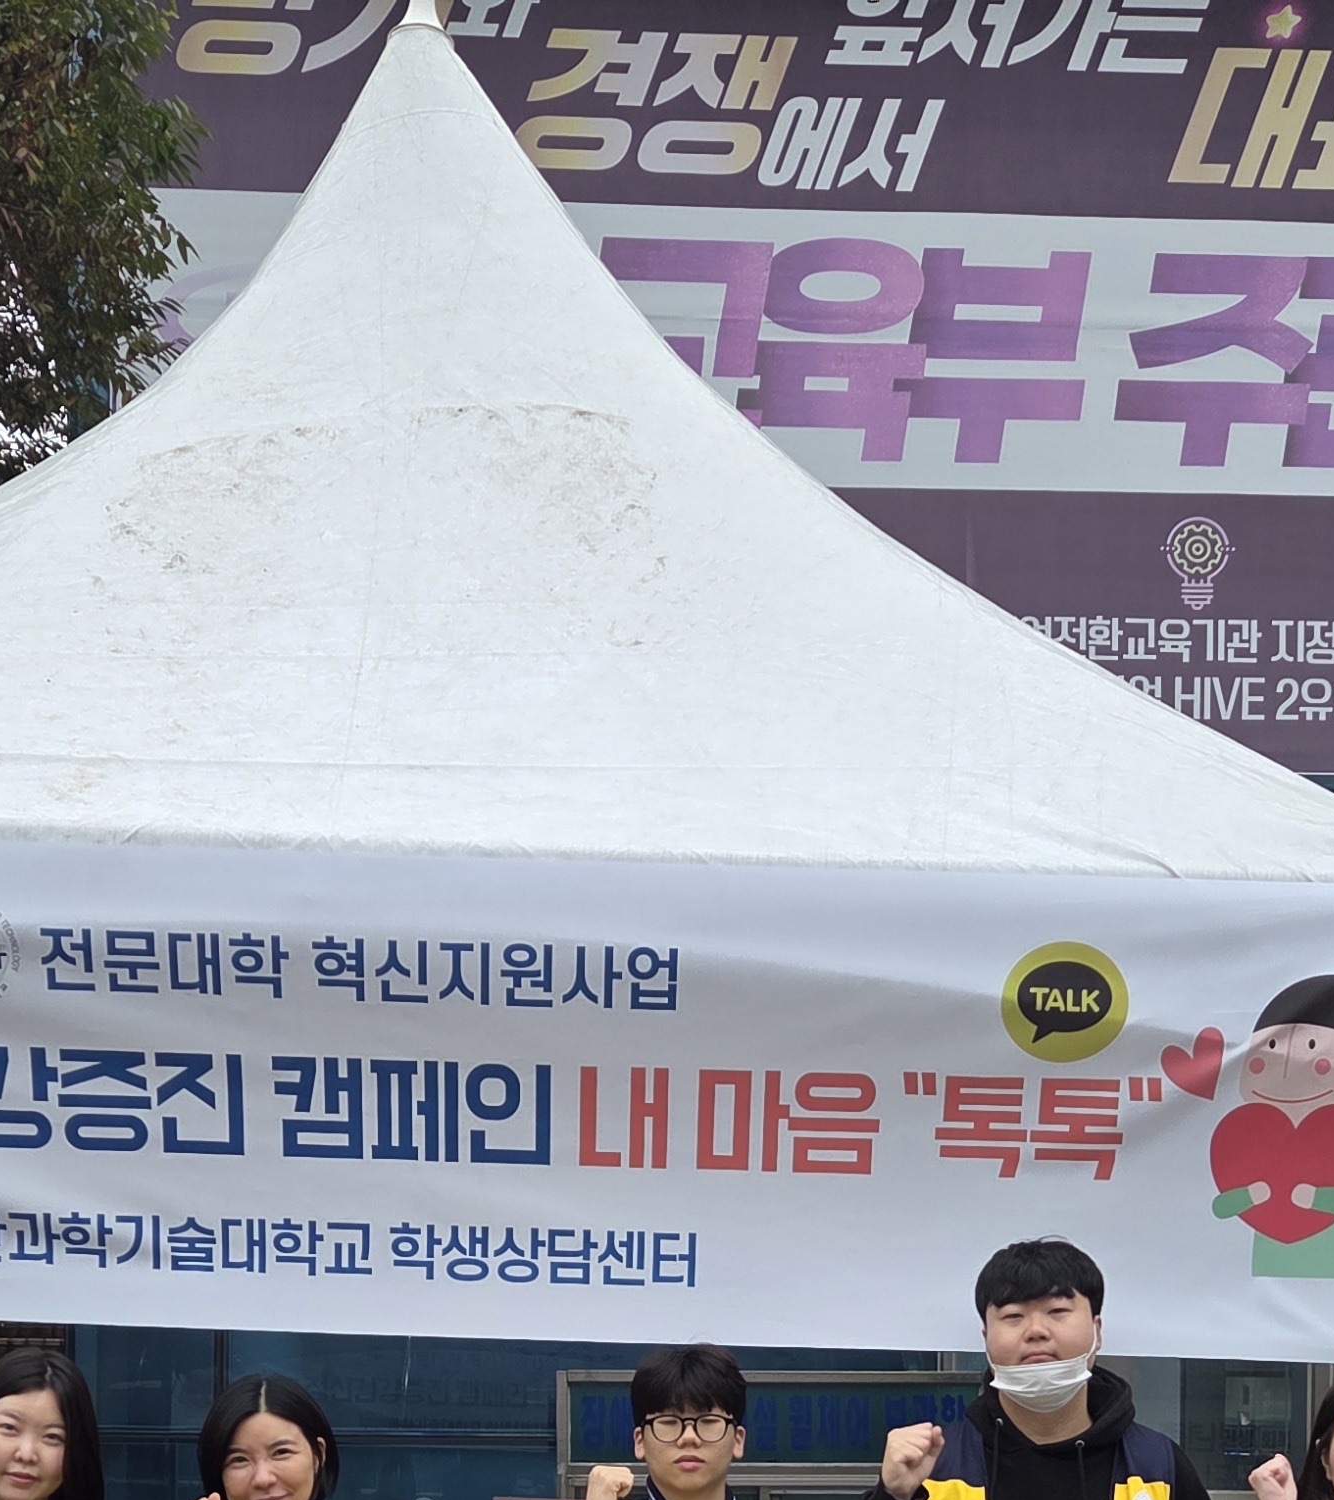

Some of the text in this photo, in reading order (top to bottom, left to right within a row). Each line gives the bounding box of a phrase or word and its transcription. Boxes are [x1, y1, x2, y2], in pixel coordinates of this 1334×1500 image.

[515, 28, 944, 192] 경쟁에서
[1175, 676, 1266, 721] HIVE
[40, 926, 680, 1012] 전문대학 혁신지원사업
[1028, 982, 1104, 1018] TALK
[273, 1050, 554, 1168] 캠페인
[577, 1065, 669, 1173] 내
[699, 1069, 879, 1176] 마음
[390, 1216, 699, 1289] 학생상담센터
